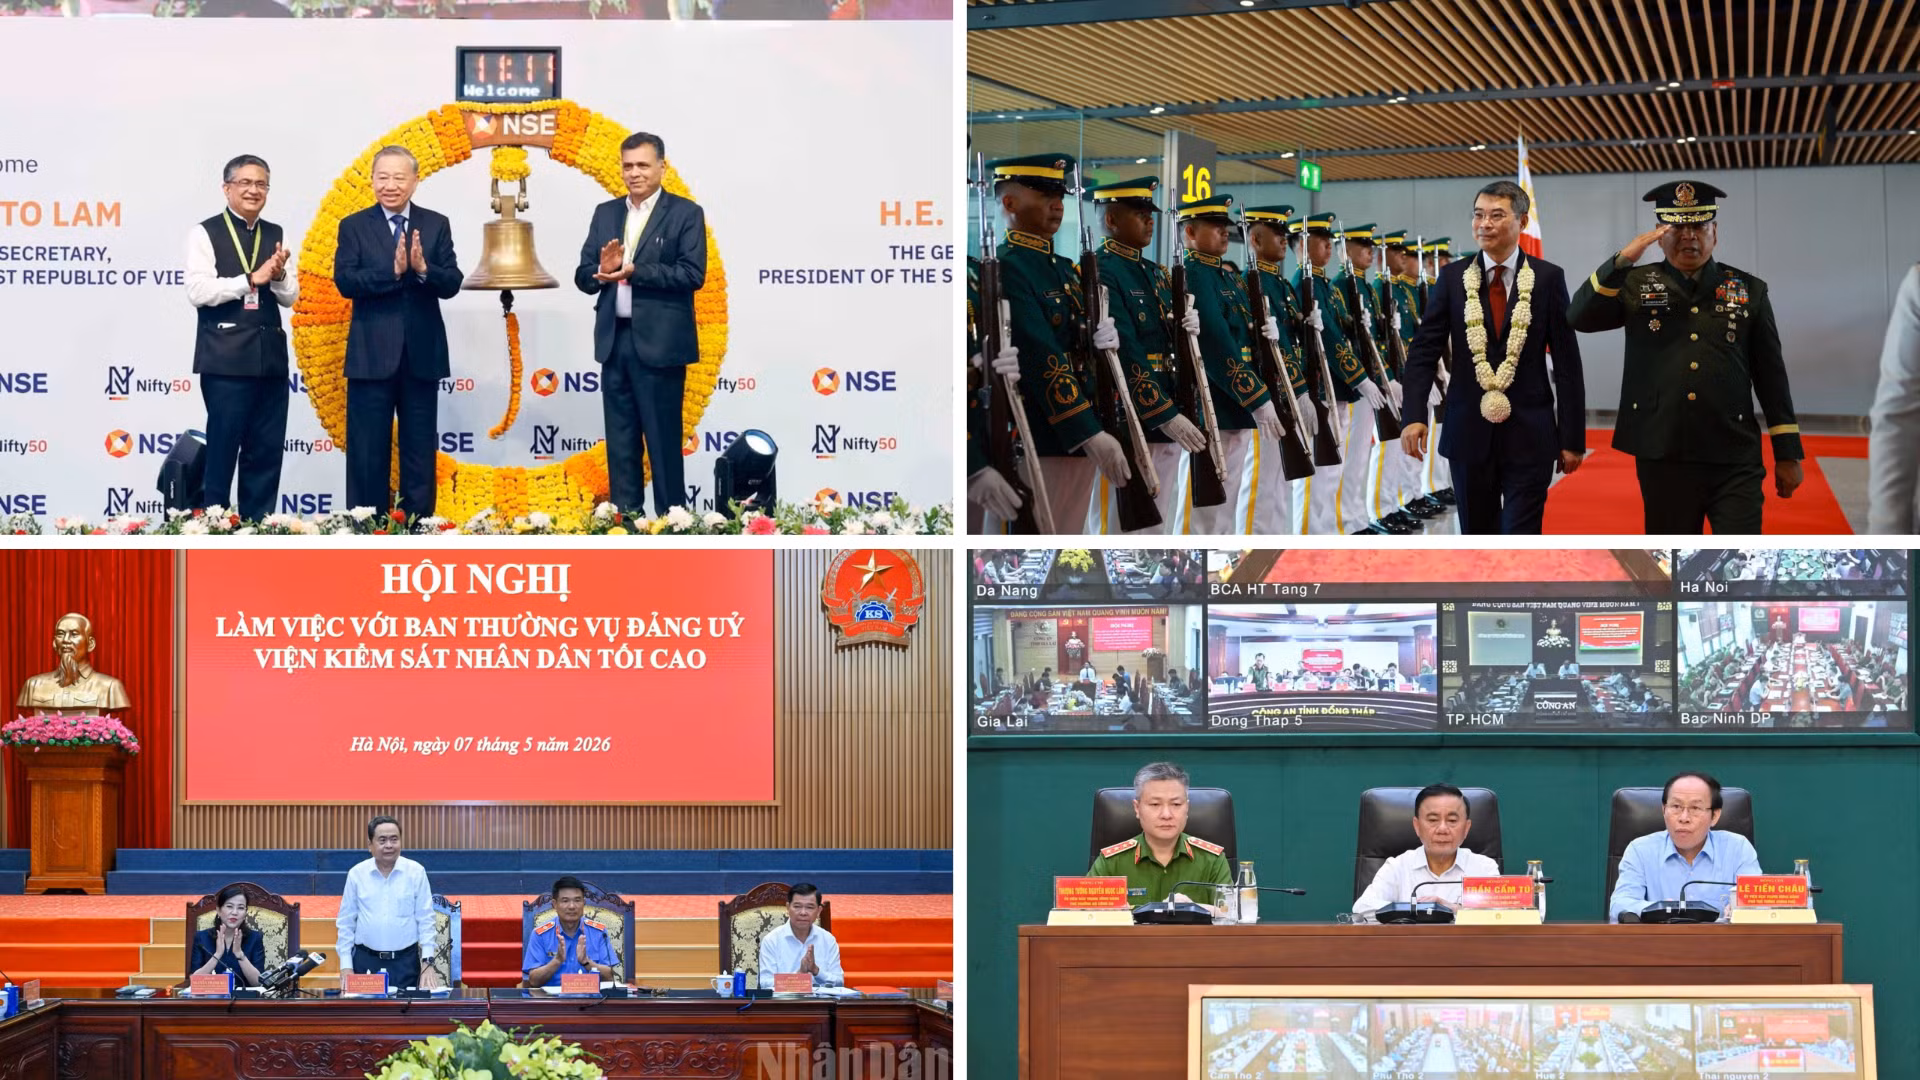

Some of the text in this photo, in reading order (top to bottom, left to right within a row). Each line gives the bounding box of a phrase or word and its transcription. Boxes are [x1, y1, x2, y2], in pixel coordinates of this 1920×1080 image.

[477, 53, 554, 83] 11:11
[463, 84, 540, 97] Welcome
[503, 113, 556, 136] NSE
[1182, 164, 1211, 203] 16
[0, 201, 121, 227] TO LAM
[880, 201, 943, 226] H.E.
[0, 246, 111, 264] SECRETARY,
[889, 245, 925, 260] THE
[23, 270, 117, 285] REPUBLIC
[123, 270, 147, 285] OF
[153, 270, 185, 285] VIE
[759, 268, 953, 284] PRESIDENT OF THE S
[136, 379, 191, 395] Nifty50
[846, 371, 896, 391] NSE
[435, 432, 474, 452] SE
[843, 437, 897, 453] Nifty50
[282, 494, 332, 514] NSE
[381, 558, 572, 602] HỘI NGHỊ
[1681, 581, 1728, 592] Ha Noi
[977, 585, 1038, 599] Da Nang
[1210, 584, 1321, 598] BCA HT Tang 7
[865, 609, 884, 619] KS
[216, 611, 746, 643] LÀM VIỆC VỚI BAN THƯỜNG VỤ ĐẢNG UỶ
[254, 643, 707, 674] VIỆN KIỂM SÁT NHÂN DÂN TỐI CAO
[977, 716, 1028, 727] Gia Lai
[1211, 715, 1303, 729] Dong Thap 5
[1446, 714, 1504, 725] TP.HCM
[1681, 713, 1771, 724] Bac Ninh DP
[350, 737, 612, 755] Hà Nội, ngày 07 tháng 5 năm 2026
[1210, 1072, 1262, 1080] Can Tho 2
[1372, 1072, 1425, 1080] Phu Tho 2
[1536, 1072, 1565, 1080] Hue 2
[1699, 1072, 1721, 1080] Thai
[1763, 1072, 1769, 1080] 2
